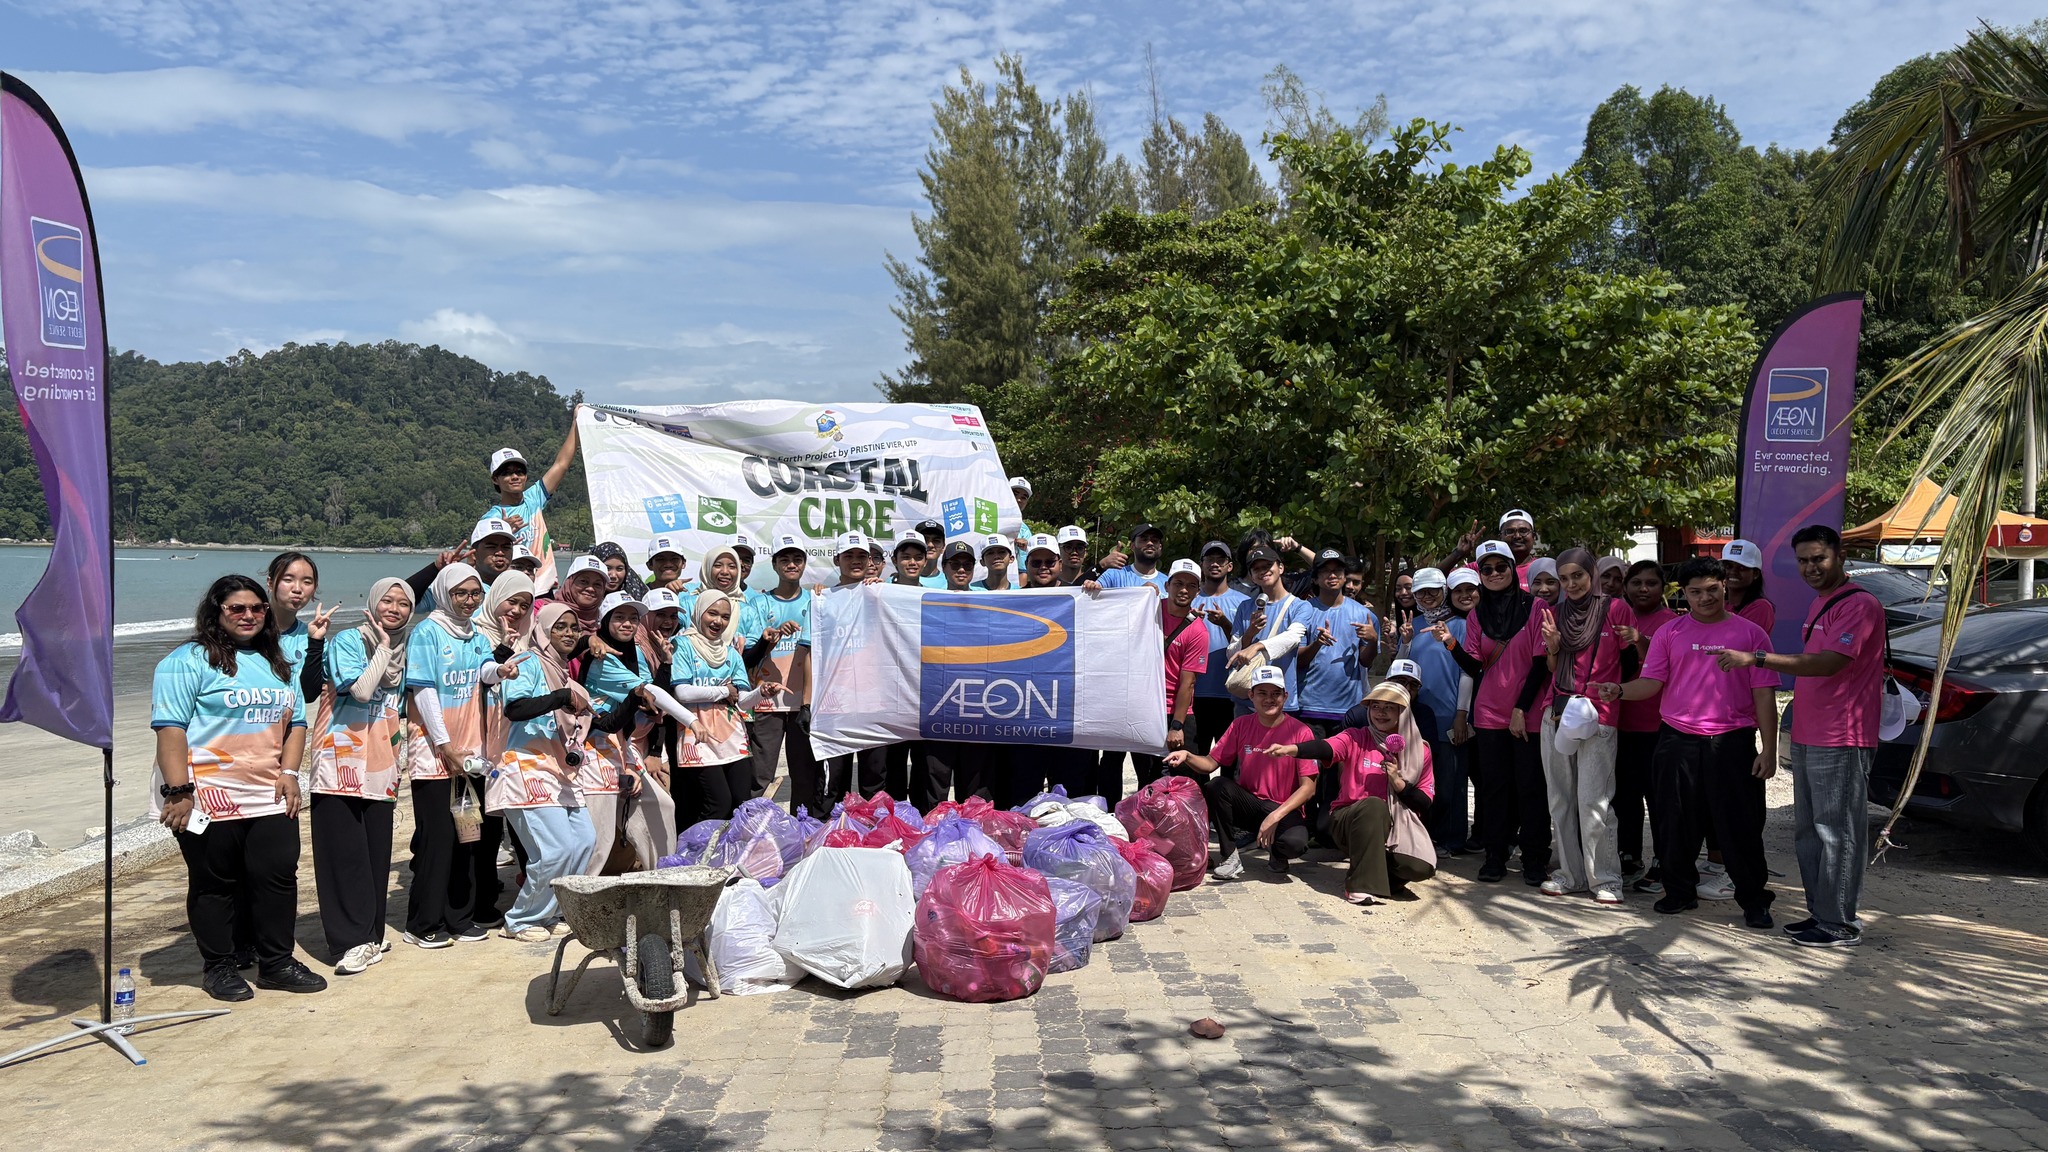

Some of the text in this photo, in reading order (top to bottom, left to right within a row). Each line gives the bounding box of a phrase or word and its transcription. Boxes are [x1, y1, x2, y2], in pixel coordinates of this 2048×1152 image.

[1791, 428, 1814, 436] SERVICE
[805, 451, 837, 462] Project
[838, 448, 849, 458] by
[850, 442, 886, 454] PRISTINE
[886, 441, 905, 450] VIER,
[905, 439, 918, 448] UTP
[1775, 451, 1833, 462] connected.
[1774, 463, 1831, 476] rewarding.
[701, 496, 709, 506] 13
[798, 498, 898, 539] CARE
[773, 640, 797, 651] CARE
[442, 668, 481, 687] COASTA
[223, 687, 296, 709] COASTA
[243, 707, 282, 724] CARE
[931, 722, 1057, 738] CREDIT SERVICE
